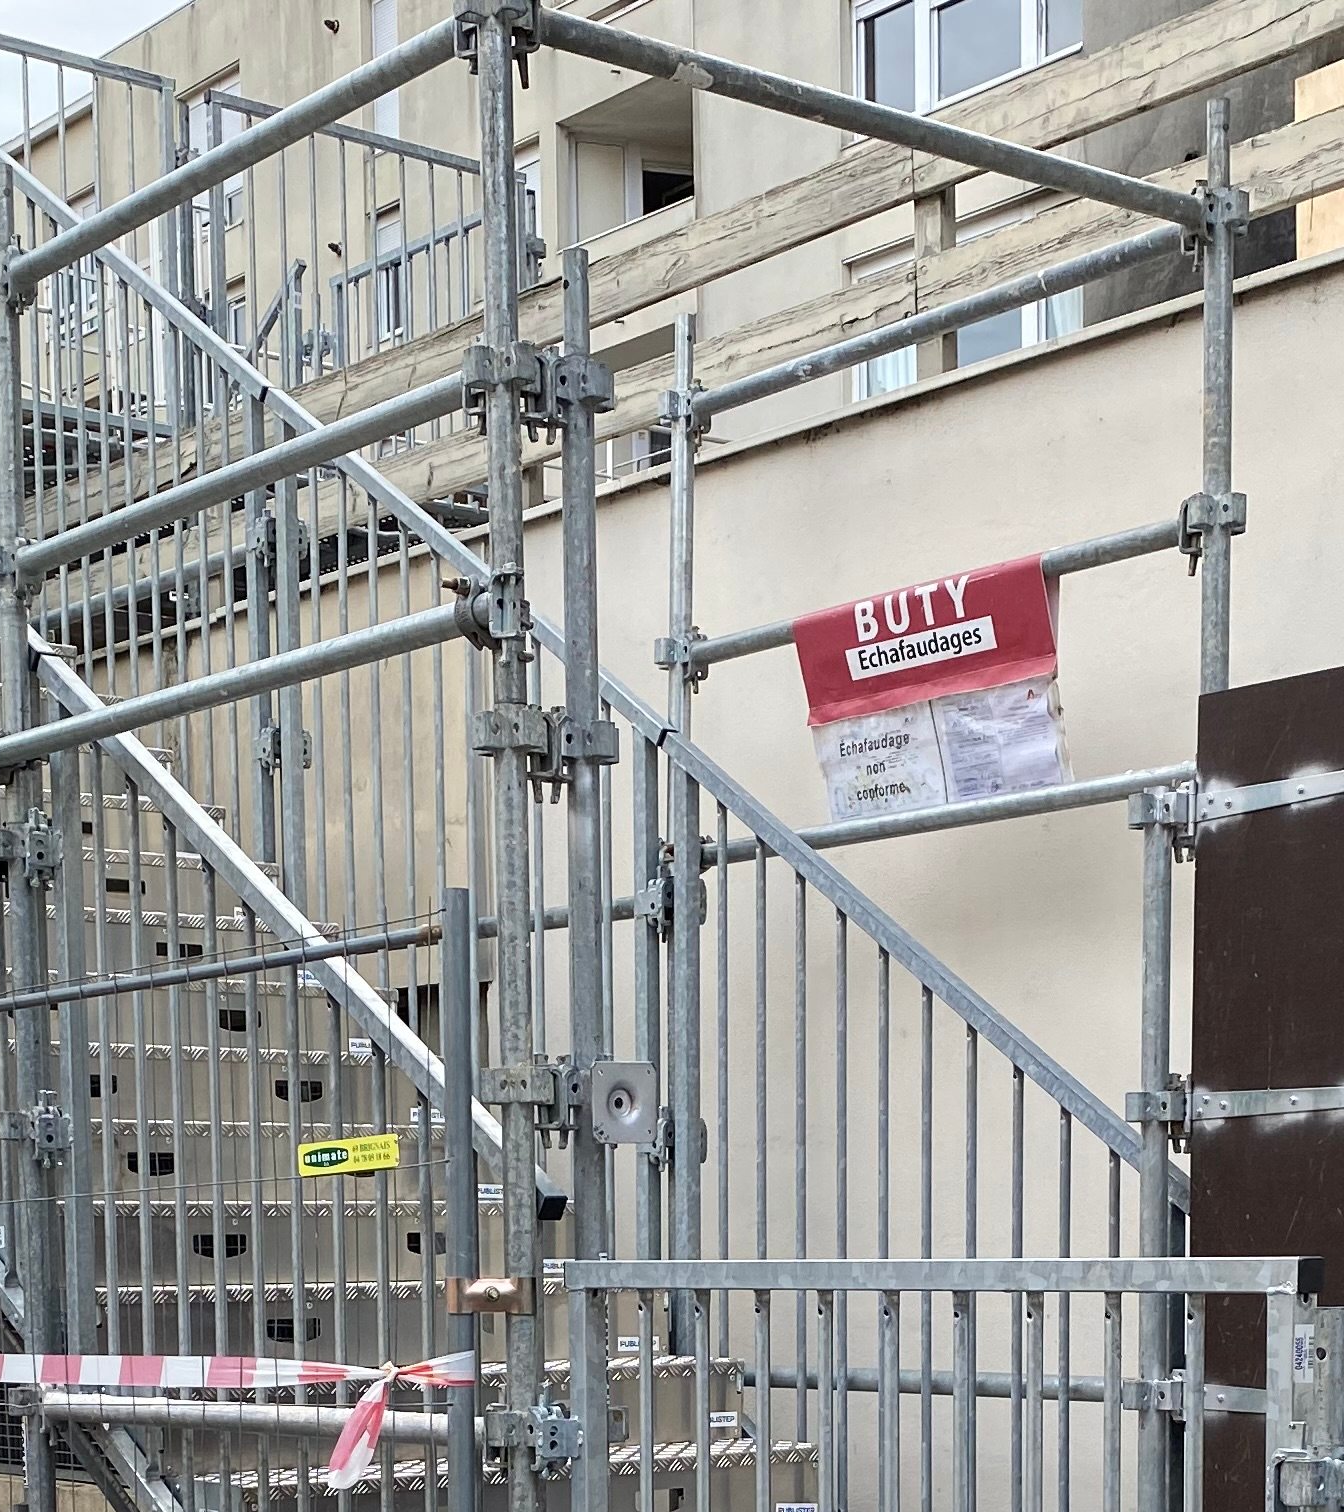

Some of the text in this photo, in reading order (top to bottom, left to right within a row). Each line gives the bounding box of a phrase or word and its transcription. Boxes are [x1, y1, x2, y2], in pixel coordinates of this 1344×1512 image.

[854, 575, 970, 642] BUTY
[858, 627, 982, 670] Echafaudages
[866, 761, 886, 775] non
[857, 782, 906, 801] conforme
[304, 1150, 348, 1164] unimate
